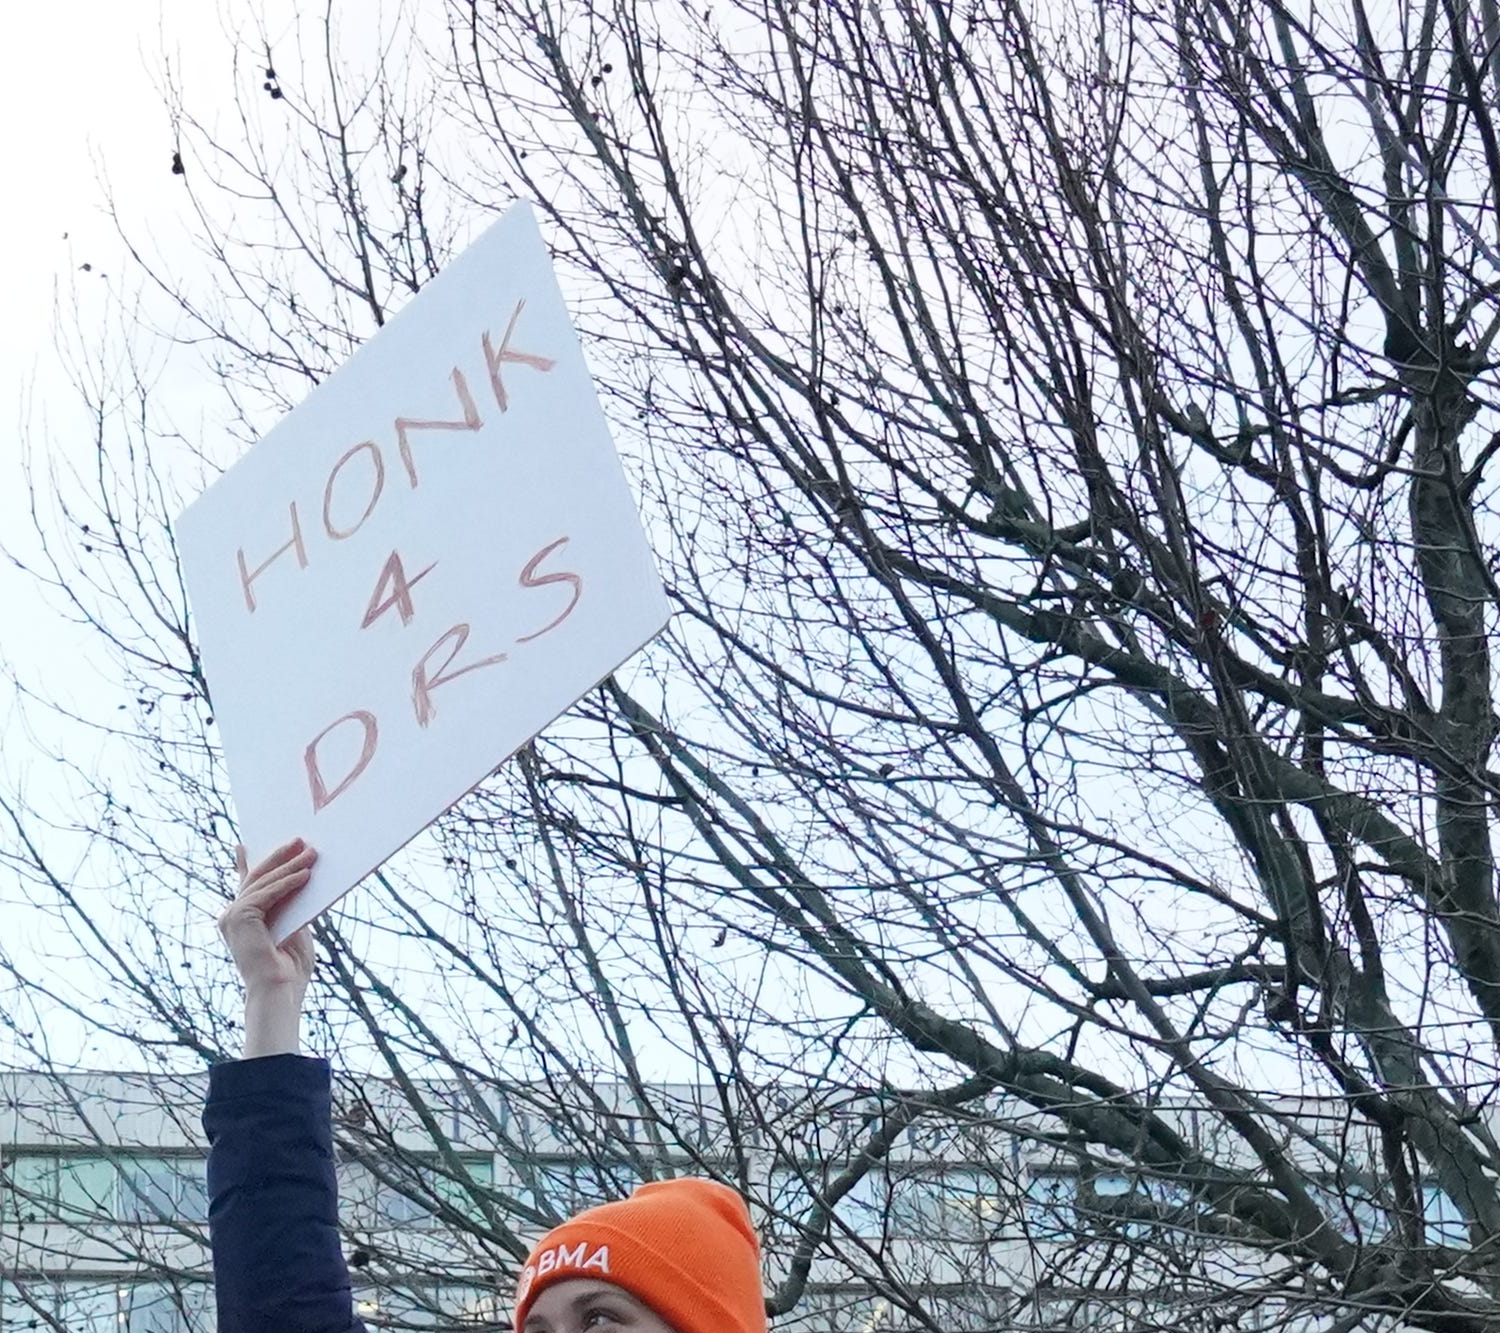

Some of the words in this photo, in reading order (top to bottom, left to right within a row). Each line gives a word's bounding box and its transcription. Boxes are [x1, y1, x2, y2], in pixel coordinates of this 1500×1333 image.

[236, 298, 558, 614] HONK
[304, 535, 582, 815] DRS
[360, 550, 439, 629] 4
[537, 1242, 611, 1277] BMA
